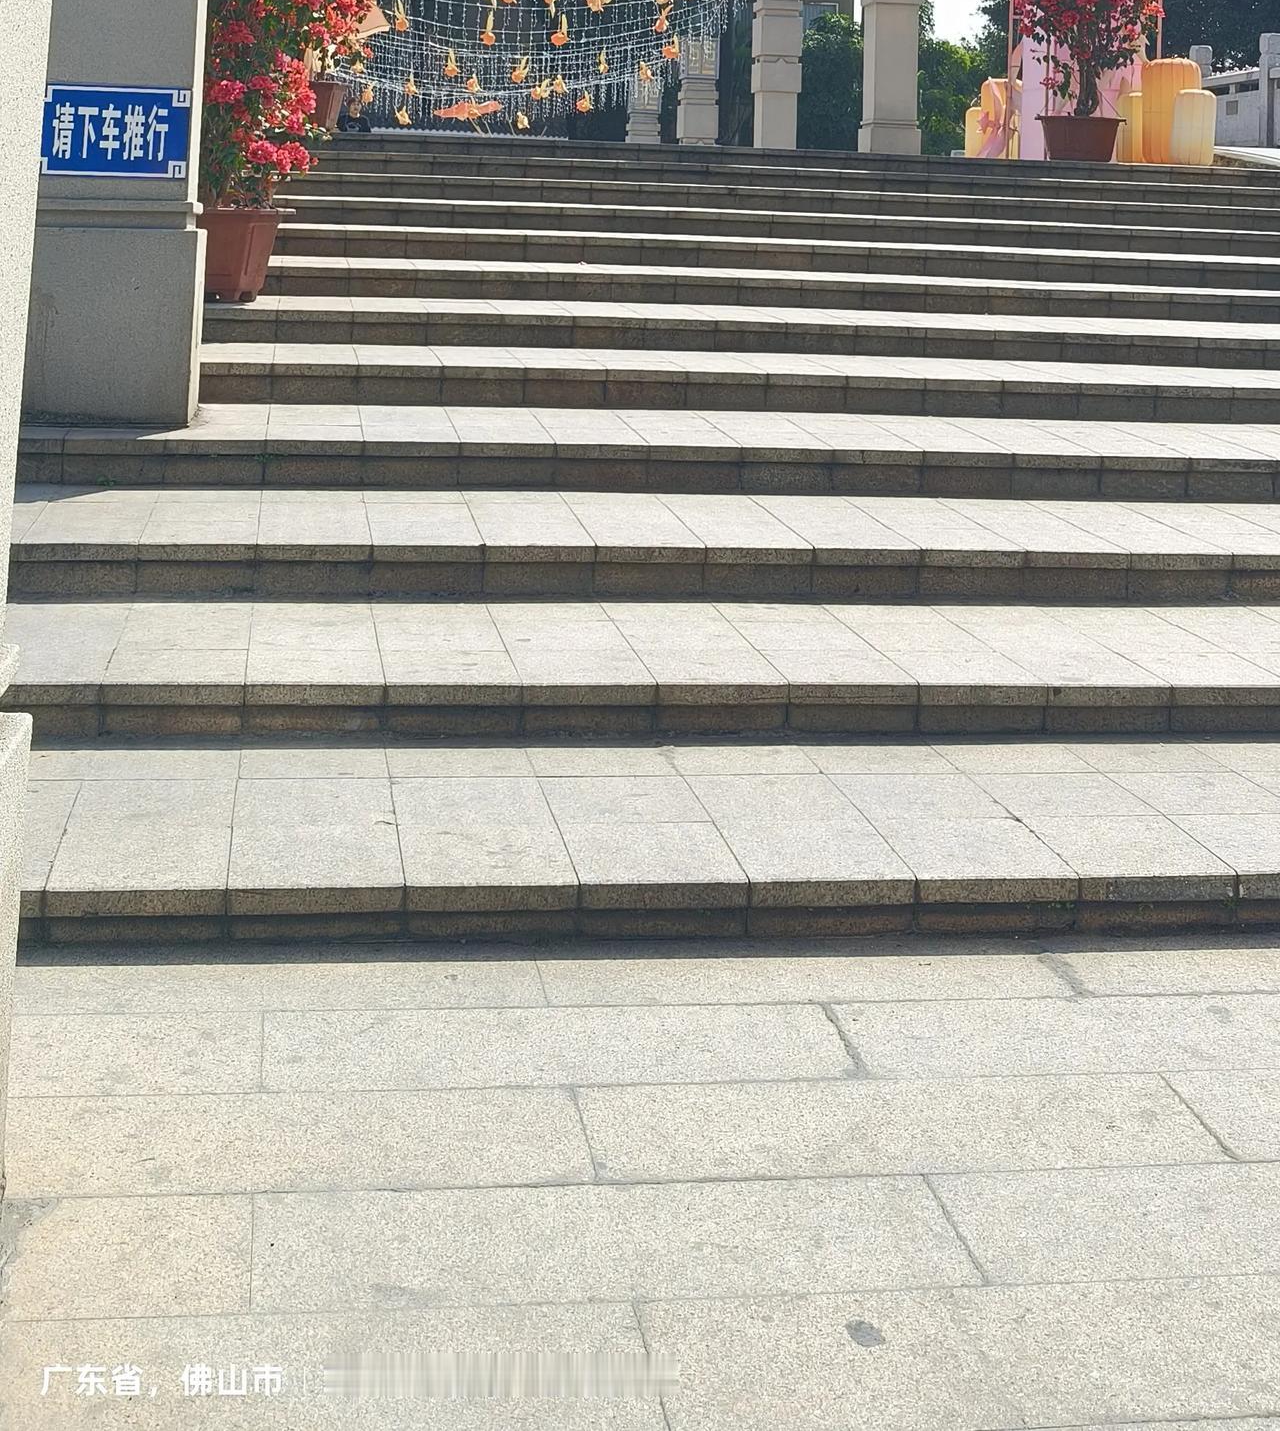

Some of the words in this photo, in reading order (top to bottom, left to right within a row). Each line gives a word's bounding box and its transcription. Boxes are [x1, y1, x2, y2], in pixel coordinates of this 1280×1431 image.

[52, 101, 169, 162] 请下车推行
